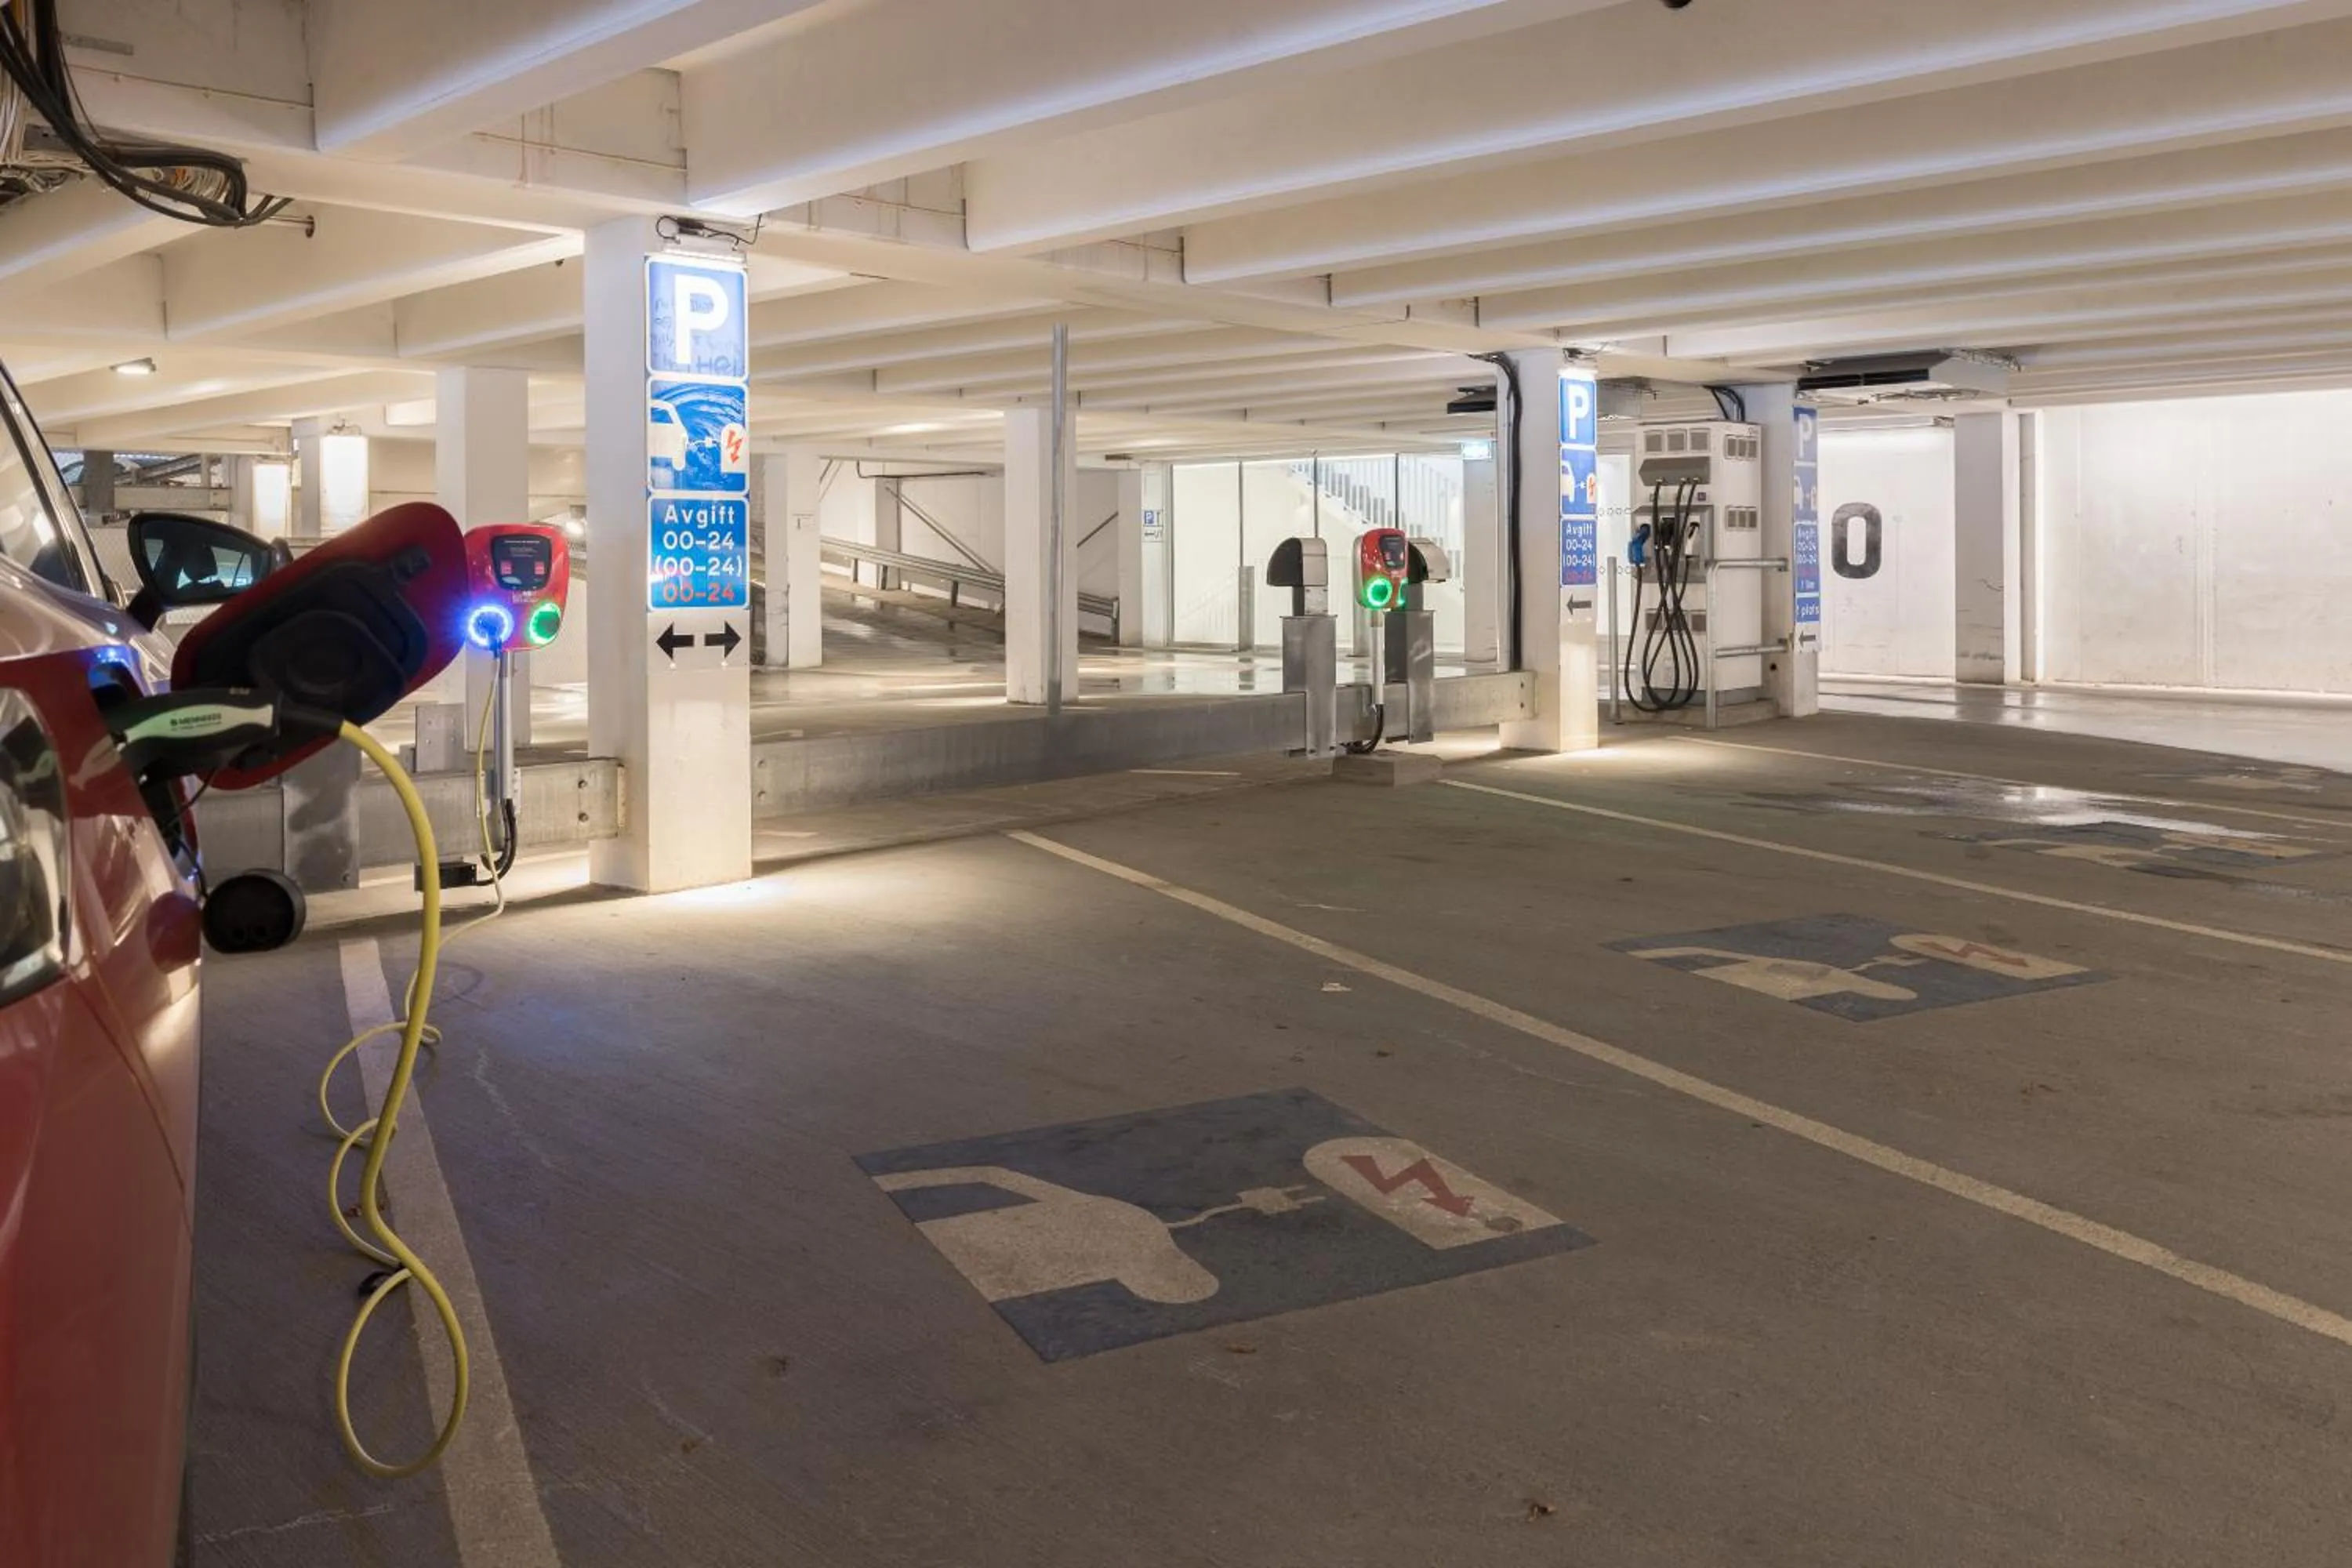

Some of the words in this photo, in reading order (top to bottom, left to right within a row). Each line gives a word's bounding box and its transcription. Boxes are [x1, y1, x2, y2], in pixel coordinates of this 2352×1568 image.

[675, 274, 728, 365] P
[1567, 383, 1589, 440] P
[1798, 413, 1812, 458] P
[664, 504, 735, 528] Avgift
[663, 531, 735, 550] 00-24
[1566, 523, 1593, 538] Avgift
[1566, 539, 1593, 551] 00-24
[655, 555, 742, 577] (00-24)
[663, 583, 735, 603] 00-24
